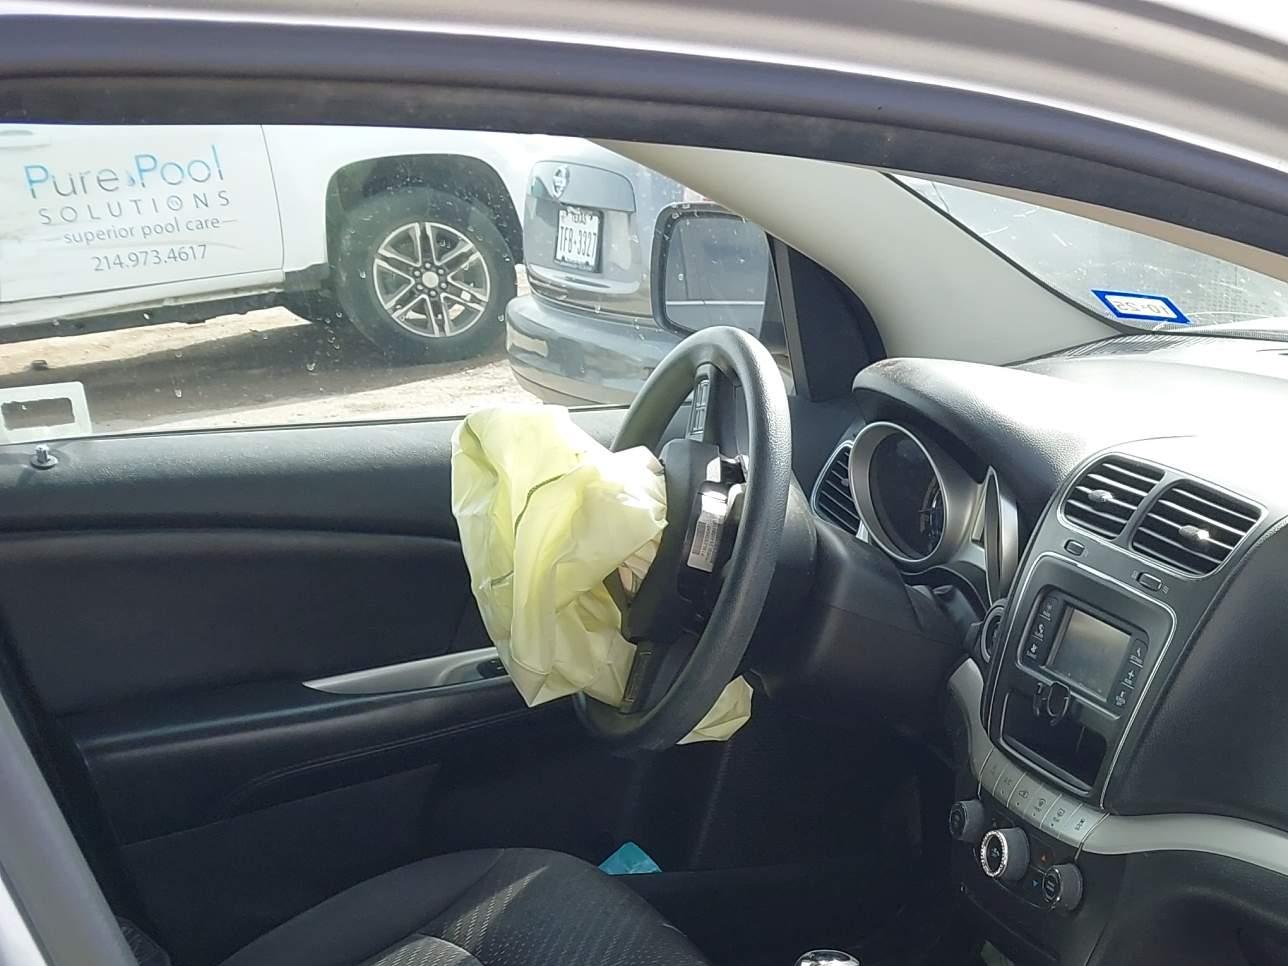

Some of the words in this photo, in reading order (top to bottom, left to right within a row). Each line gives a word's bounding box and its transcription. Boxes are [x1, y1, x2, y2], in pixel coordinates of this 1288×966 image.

[24, 164, 119, 199] Pure
[134, 144, 224, 188] Pool
[38, 190, 231, 225] SOLUTIONS
[63, 225, 135, 245] superior
[141, 217, 181, 239] pool
[185, 216, 221, 231] care
[91, 244, 208, 272] 214.973.4617
